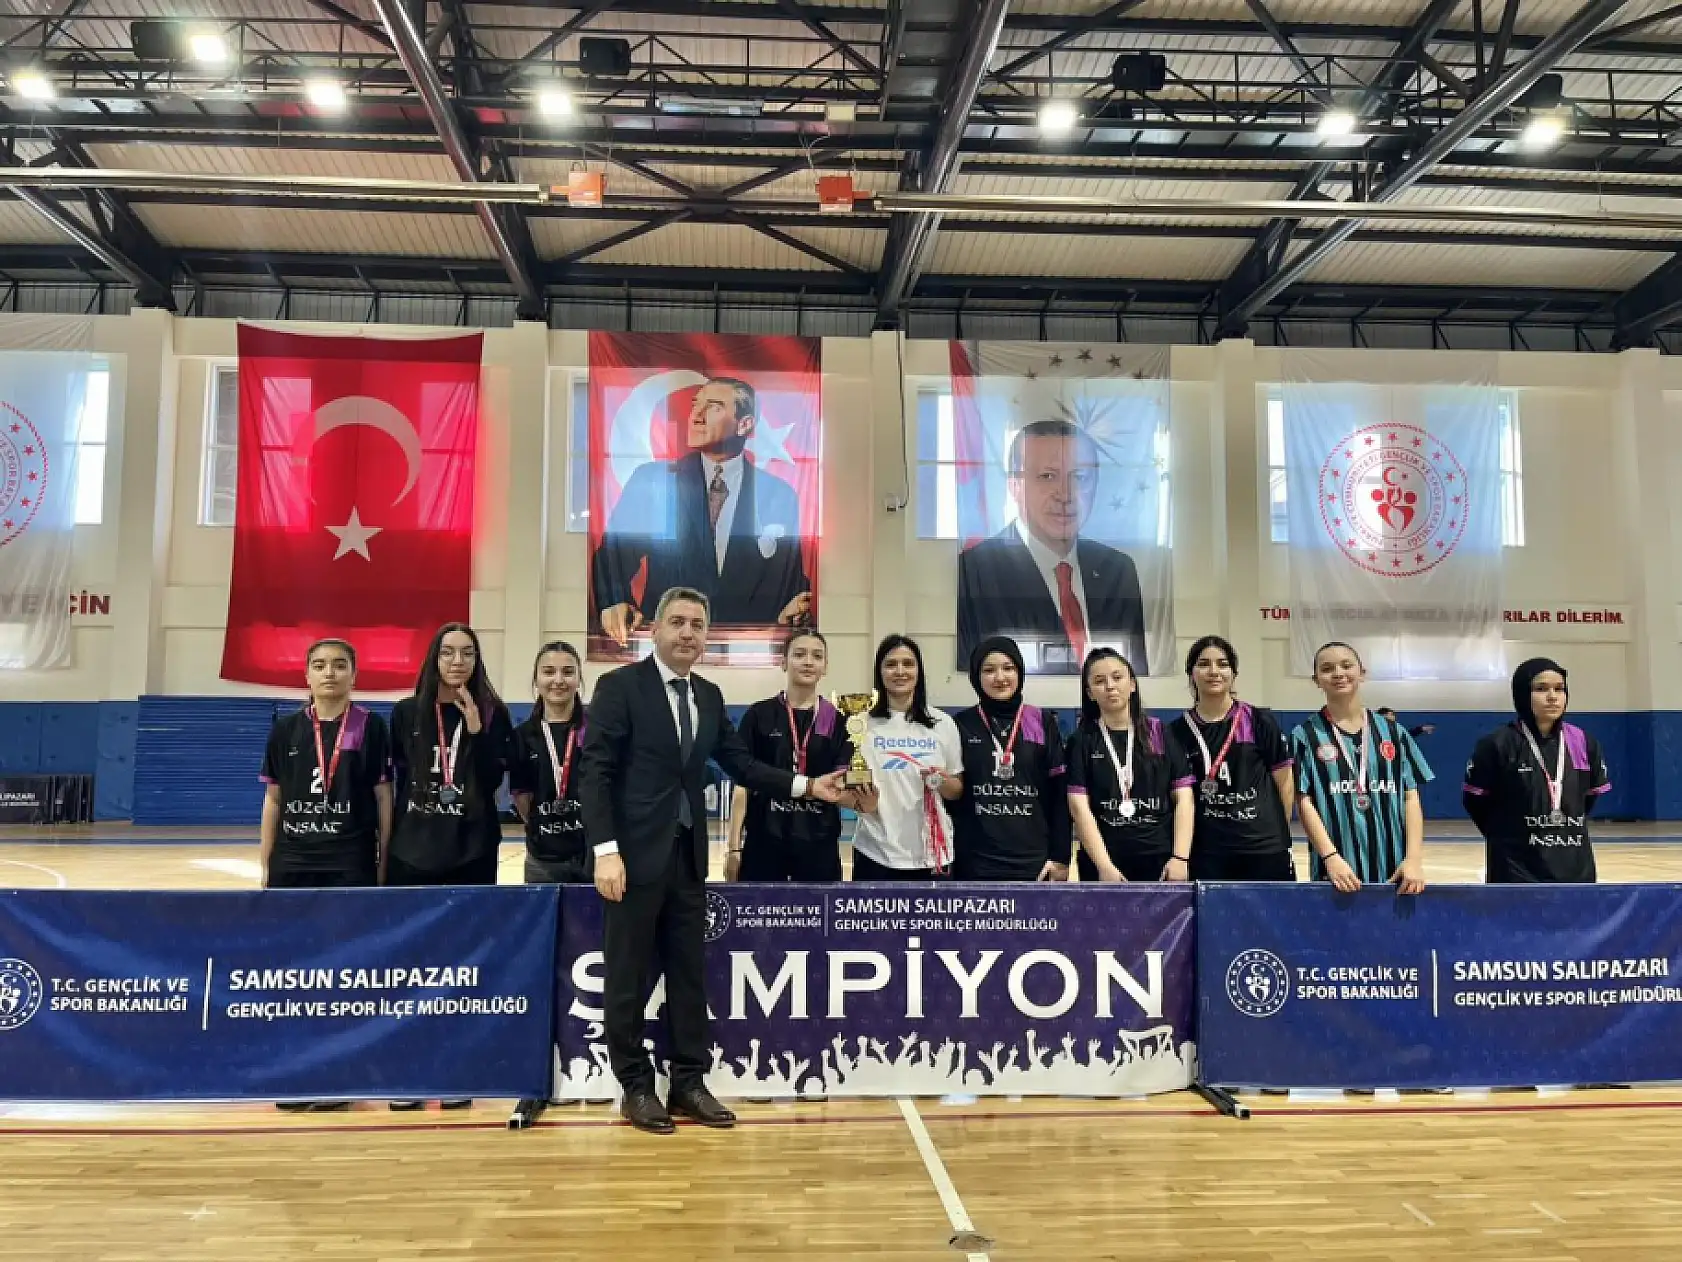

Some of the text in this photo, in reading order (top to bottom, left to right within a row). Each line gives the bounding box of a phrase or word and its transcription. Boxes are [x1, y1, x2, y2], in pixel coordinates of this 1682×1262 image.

[873, 736, 937, 749] Reebok
[310, 767, 324, 794] 2
[735, 903, 822, 917] T.C. GENÇLİK VE
[834, 898, 1016, 914] SAMSUN SALIPAZARI
[735, 916, 822, 928] SPOR BAKANLIĞI
[834, 917, 1058, 934] GENÇLİK VE SPOR İLÇE MÜDÜRLÜĞÜ
[1297, 965, 1418, 984] T.C. GENÇLİK VE
[1453, 957, 1669, 981] SAMSUN SALIPAZARI
[51, 975, 189, 996] T.C. GENÇLİK VE
[229, 967, 479, 991] SAMSUN SALIPAZARI
[1297, 983, 1419, 1000] SPOR BAKANLIĞI
[1454, 988, 1522, 1010] GENÇLİK
[1523, 991, 1543, 1006] VE
[1545, 991, 1585, 1006] SPOR
[1588, 987, 1617, 1008] İLÇE
[50, 994, 187, 1012] SPOR BAKANLIĞI
[227, 995, 528, 1022] GENÇLİK VE SPOR İLÇE MÜDÜRLÜĞÜ
